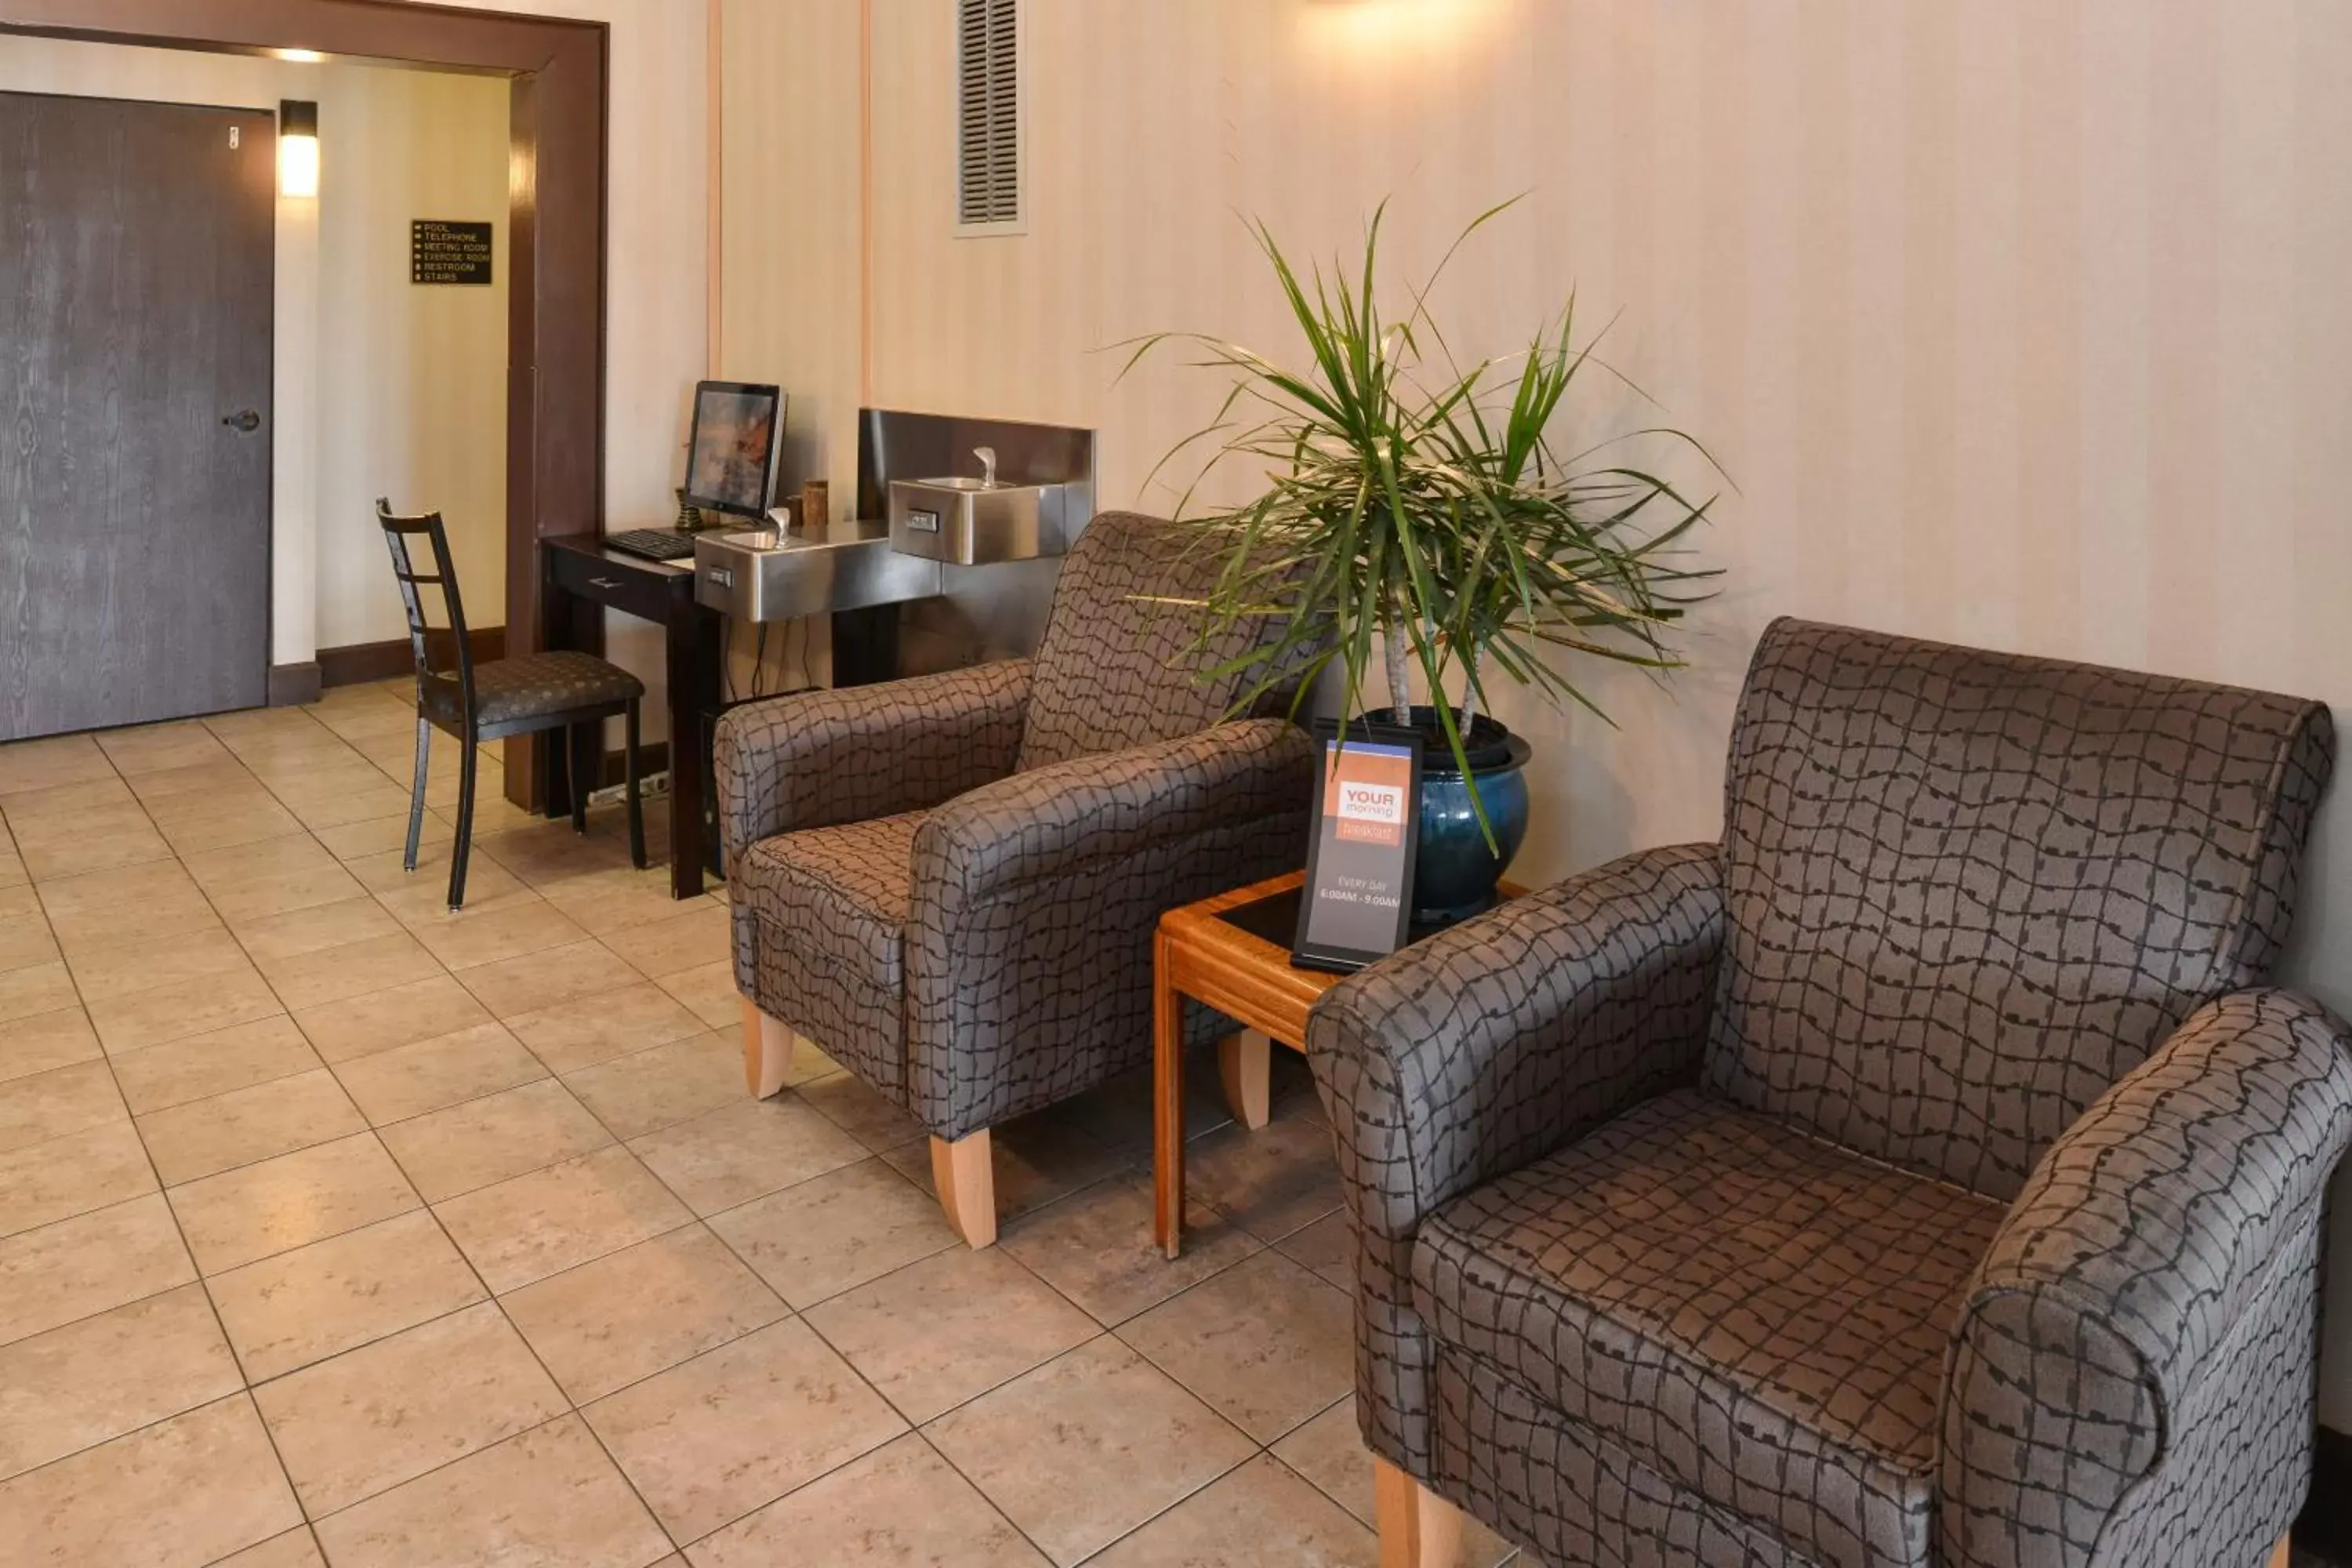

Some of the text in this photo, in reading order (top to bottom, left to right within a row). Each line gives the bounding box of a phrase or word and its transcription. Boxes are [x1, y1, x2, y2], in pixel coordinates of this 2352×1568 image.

[424, 223, 451, 232] POOL
[426, 232, 477, 242] TELEPHONE
[424, 242, 460, 251] MEETING
[467, 253, 490, 262] ROOM
[424, 263, 476, 271] RESTROOM
[424, 272, 458, 281] STAIRS
[1346, 789, 1394, 805] YOUR
[1346, 803, 1393, 818] morning
[1342, 821, 1392, 840] breakfast
[1338, 876, 1388, 892] EVERY DAY
